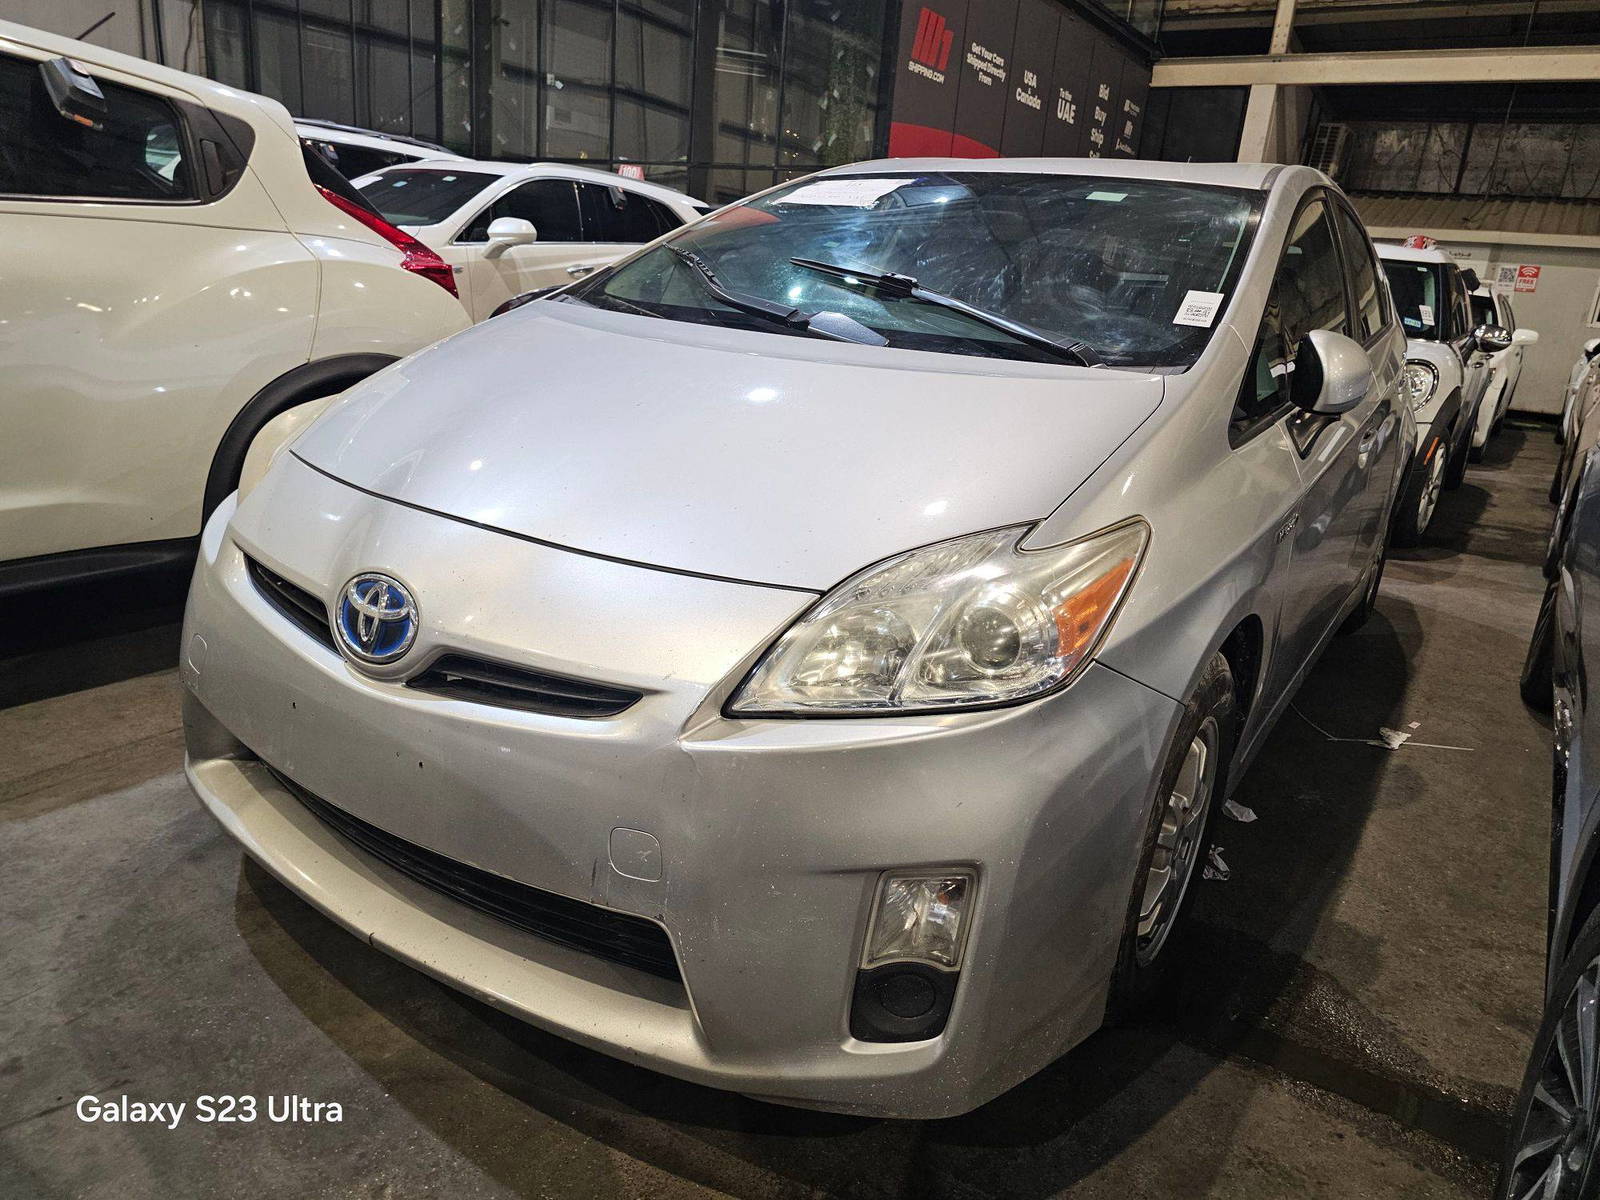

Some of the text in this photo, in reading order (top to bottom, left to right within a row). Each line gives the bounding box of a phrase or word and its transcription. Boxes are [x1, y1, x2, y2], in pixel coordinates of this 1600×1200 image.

[1024, 70, 1037, 88] USA
[1016, 87, 1041, 110] Canada
[1099, 84, 1110, 101] Bid
[1057, 98, 1076, 124] UAE
[1095, 105, 1107, 127] Buy
[1091, 127, 1104, 149] Ship
